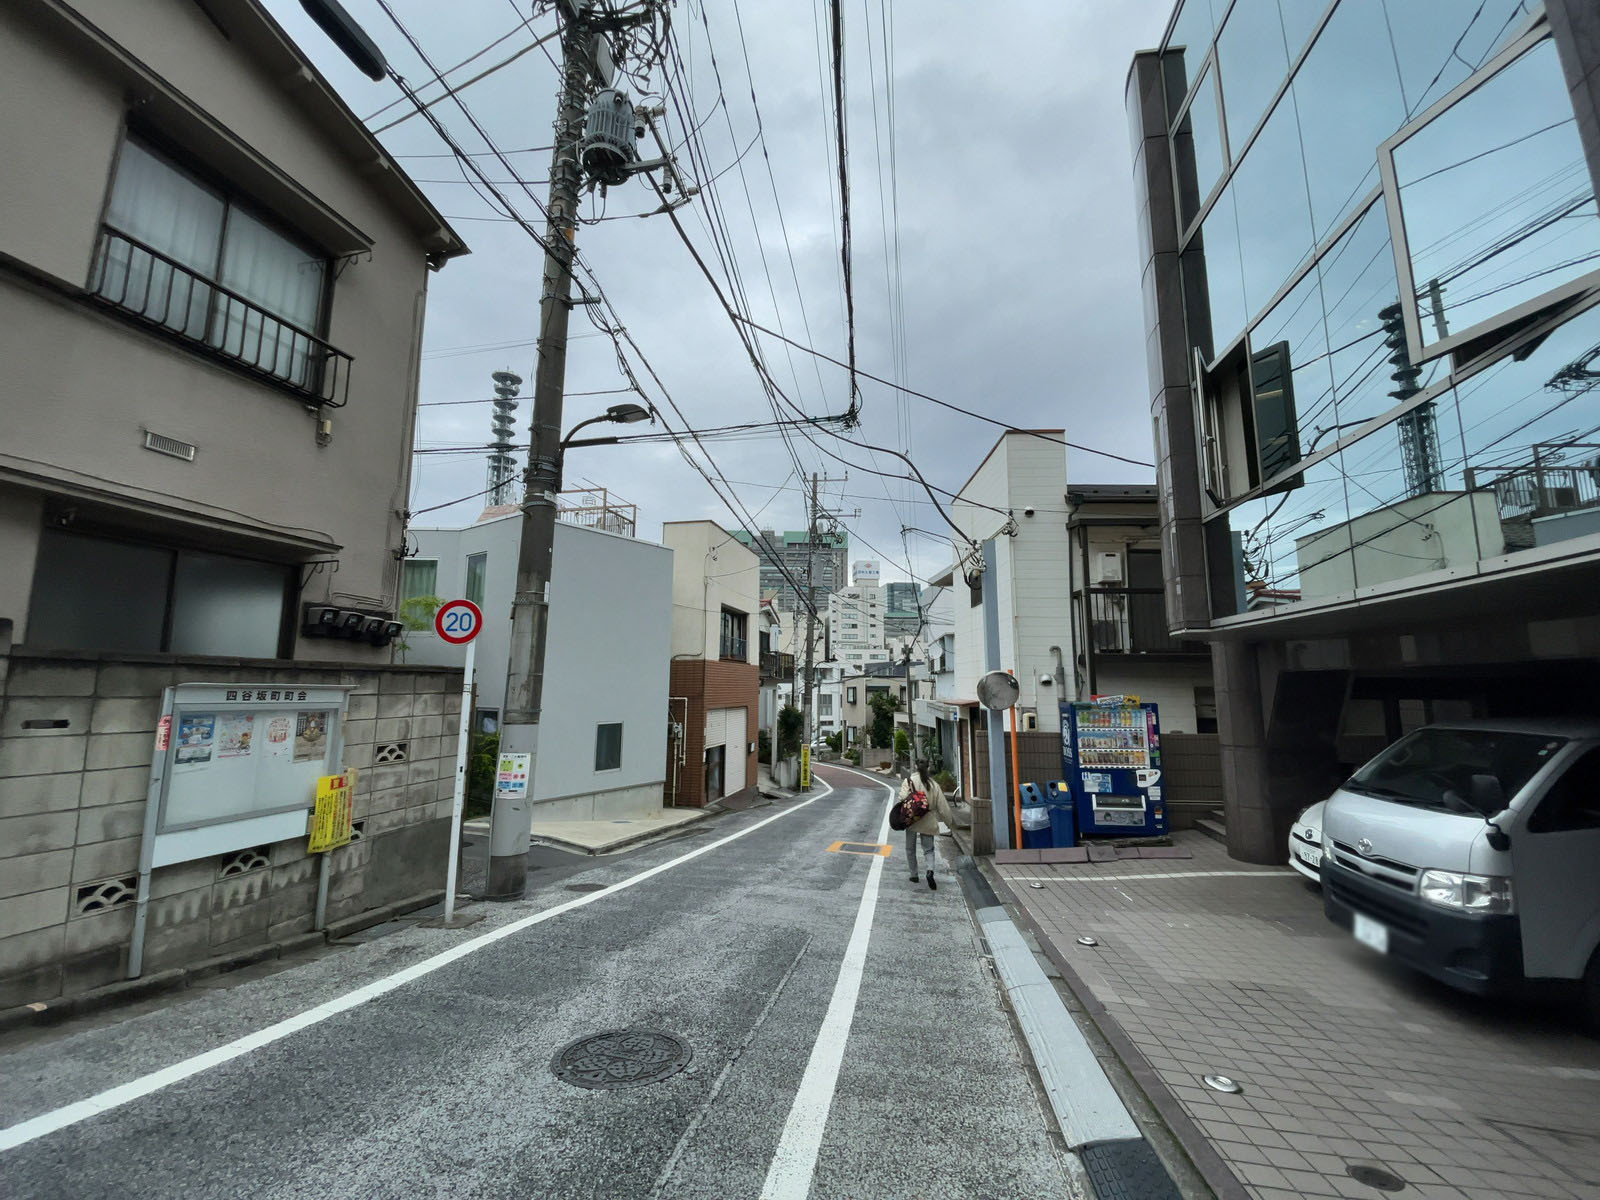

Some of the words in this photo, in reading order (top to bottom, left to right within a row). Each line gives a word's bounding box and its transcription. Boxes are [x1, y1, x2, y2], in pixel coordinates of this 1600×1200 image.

[445, 611, 472, 632] 20
[226, 690, 307, 701] 四谷坂町町会
